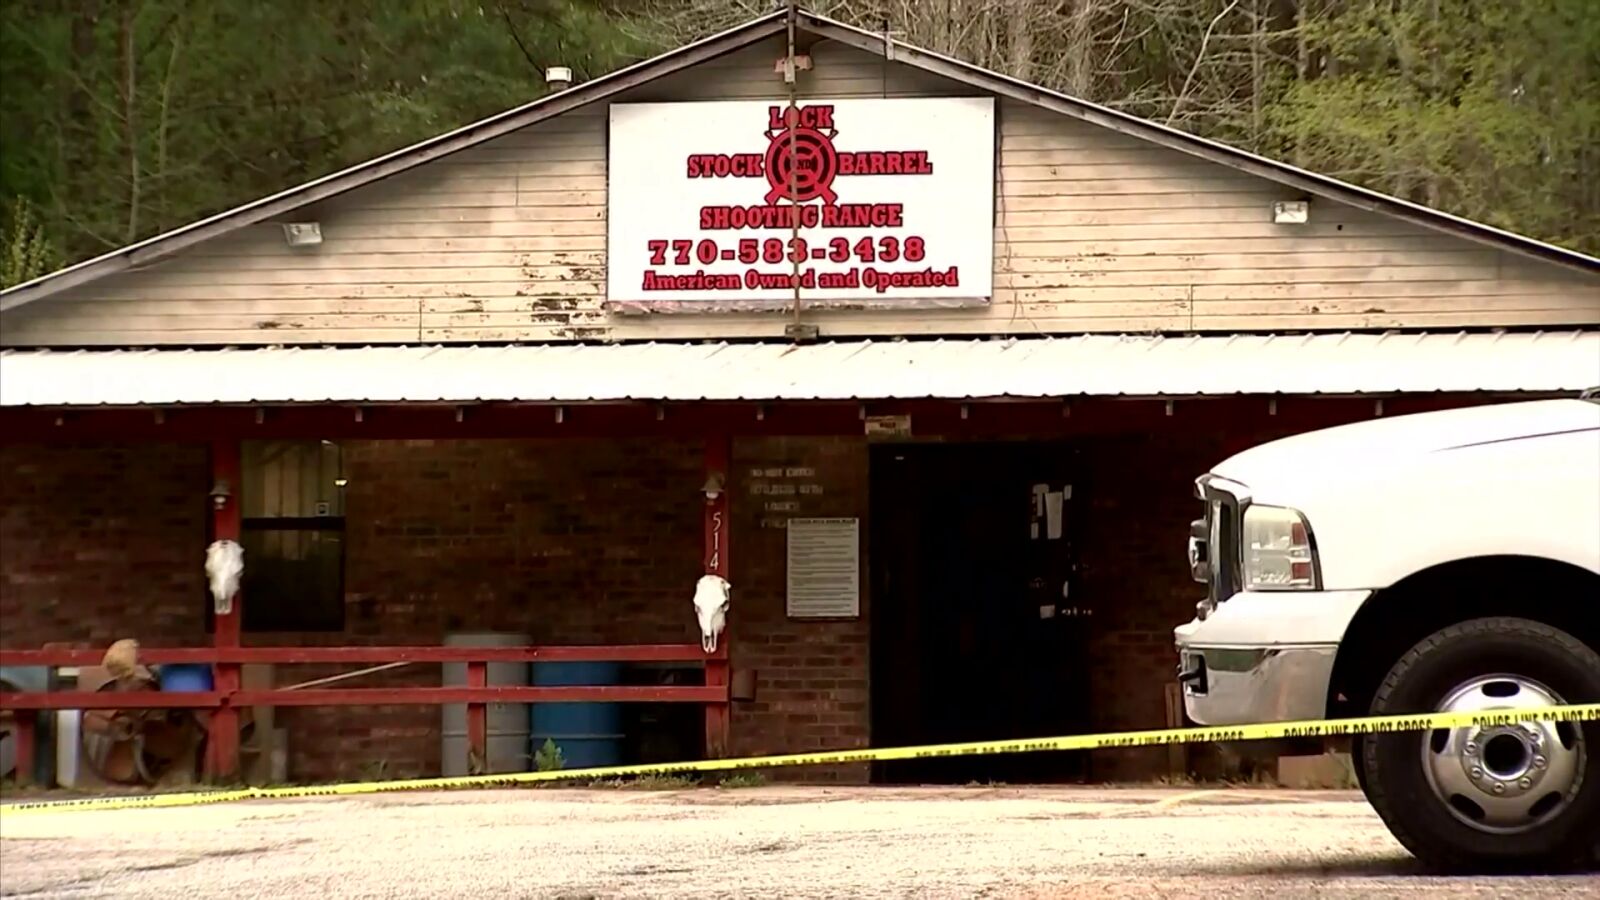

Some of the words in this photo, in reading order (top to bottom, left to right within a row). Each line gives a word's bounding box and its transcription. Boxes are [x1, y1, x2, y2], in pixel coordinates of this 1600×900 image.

[768, 104, 834, 130] LOCK
[687, 153, 764, 178] STOCK
[838, 151, 932, 175] BARREL
[700, 205, 819, 230] SHOOTING
[822, 203, 903, 228] RANGE
[648, 236, 926, 265] 770-583-3438
[642, 270, 741, 291] American
[818, 267, 858, 289] and
[862, 266, 959, 293] Operated
[710, 511, 721, 570] 514
